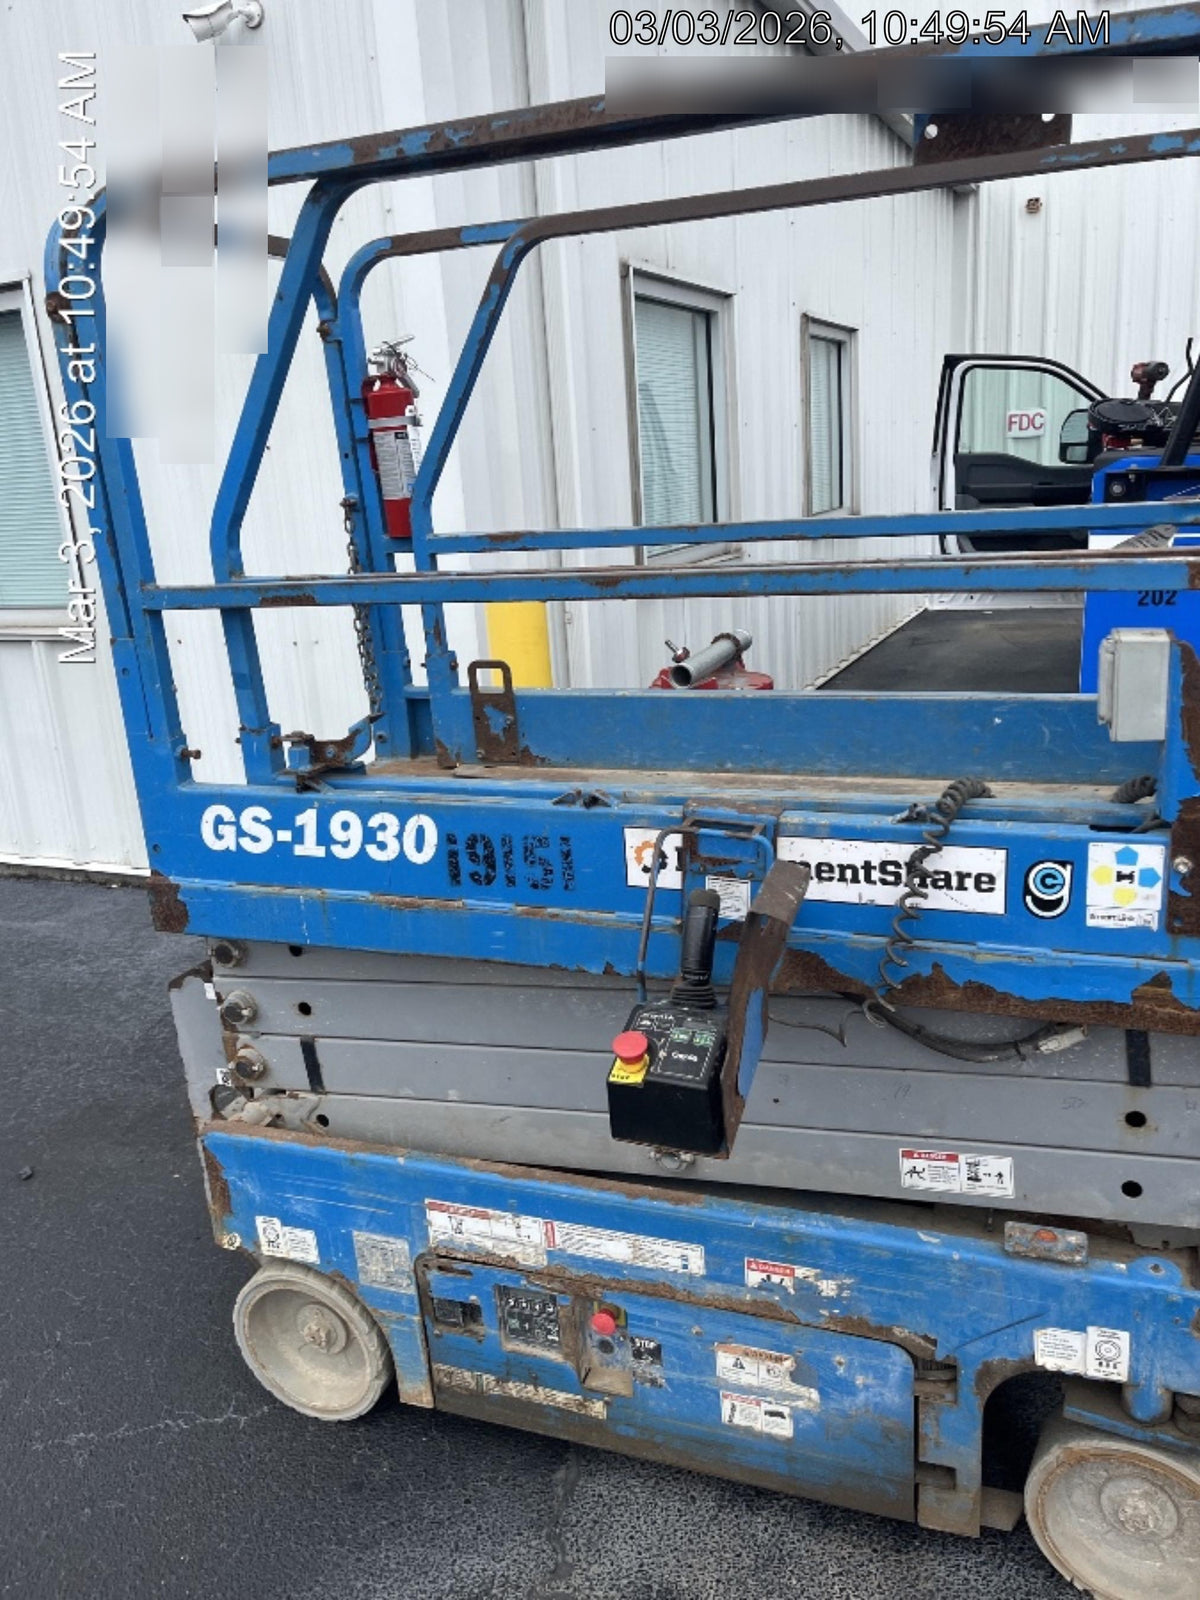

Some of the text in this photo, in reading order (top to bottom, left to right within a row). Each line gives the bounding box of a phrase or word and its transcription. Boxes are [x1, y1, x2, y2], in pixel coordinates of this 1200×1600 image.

[1008, 411, 1044, 432] FDC
[1138, 590, 1177, 606] 202
[200, 804, 438, 865] GS-1930
